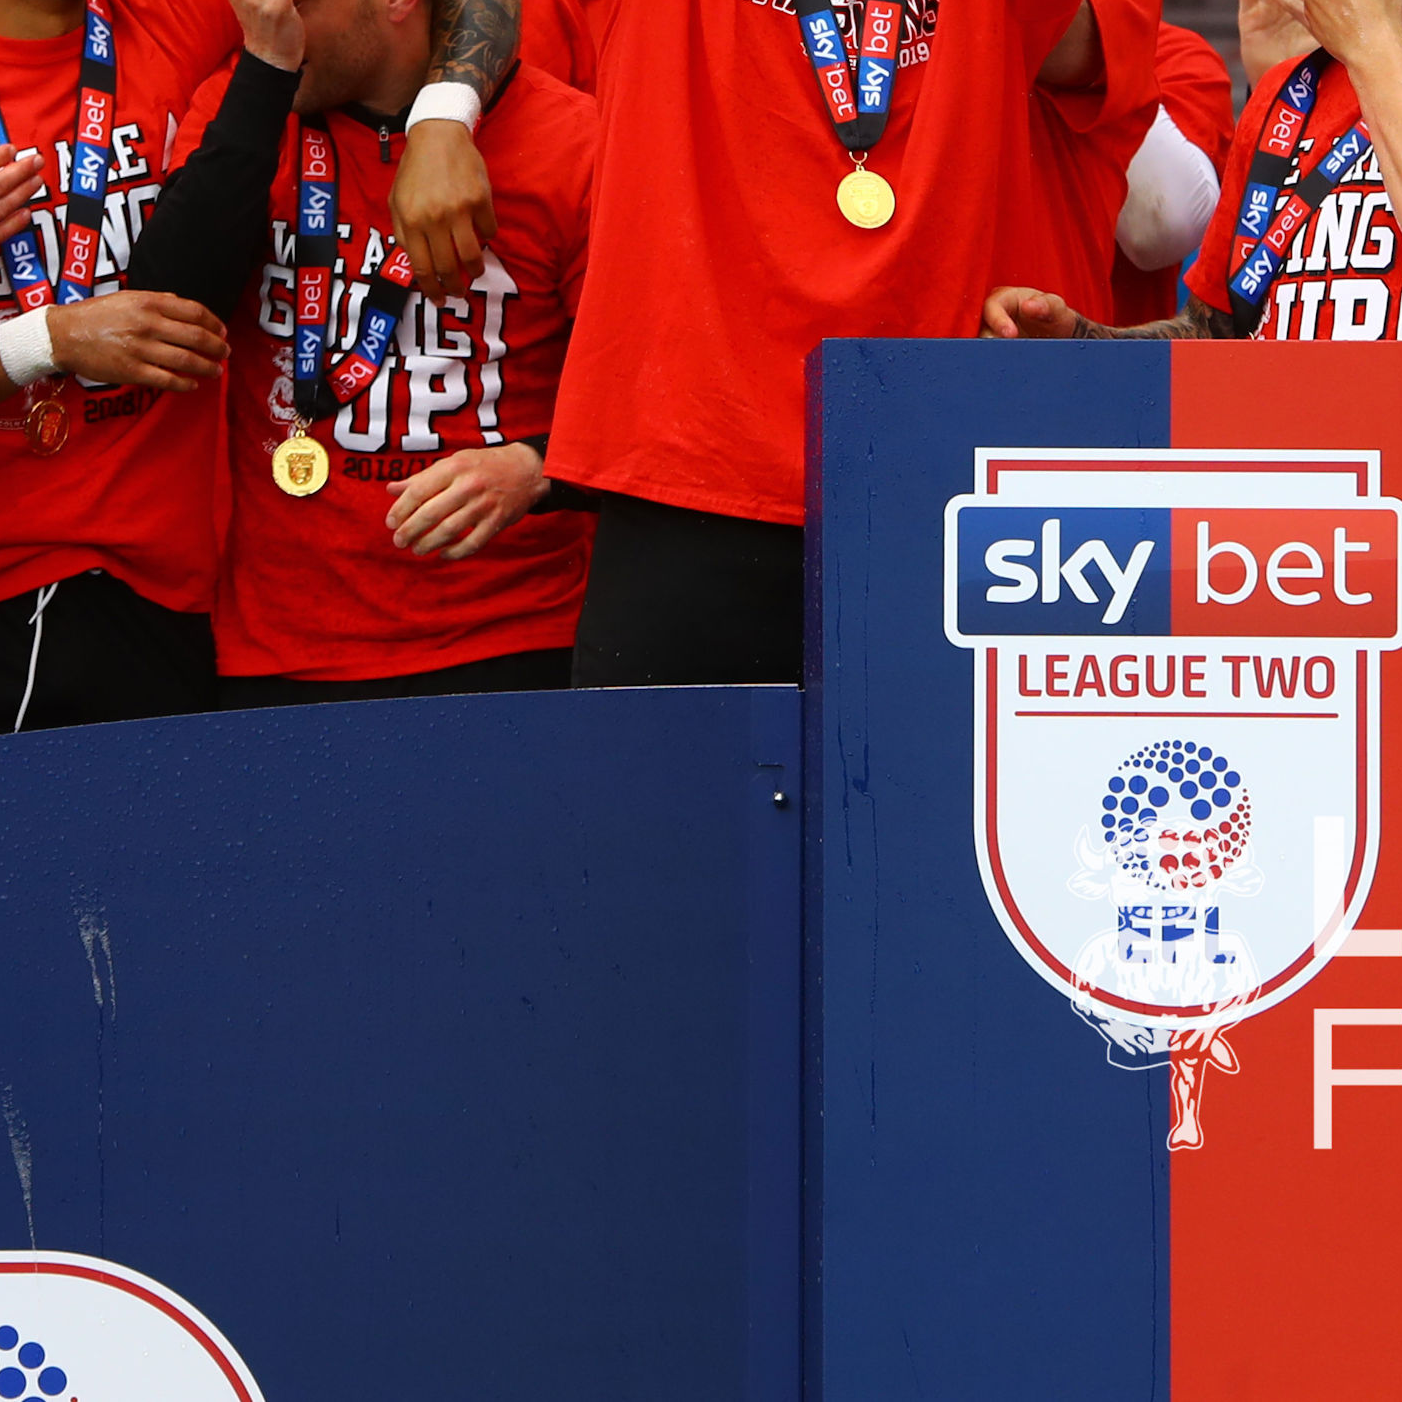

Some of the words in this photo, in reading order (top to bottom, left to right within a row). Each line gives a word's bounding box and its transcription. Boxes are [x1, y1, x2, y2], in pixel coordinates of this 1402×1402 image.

[89, 16, 111, 58] sky
[865, 7, 893, 53] bet
[809, 18, 838, 60] sky
[826, 68, 854, 116] bet
[896, 42, 931, 70] 019
[860, 60, 890, 107] sky
[1288, 68, 1312, 108] sky
[80, 96, 106, 140] bet
[1269, 108, 1302, 152] bet
[77, 145, 105, 191] sky
[304, 134, 326, 177] bet
[1326, 134, 1359, 174] sky
[303, 185, 332, 229] sky
[1242, 190, 1269, 235] sky
[12, 240, 38, 281] sky
[65, 231, 91, 279] bet
[1241, 249, 1273, 295] sky
[1268, 203, 1303, 248] bet
[299, 273, 322, 320] bet
[298, 329, 322, 373] sky
[362, 315, 387, 360] sky
[334, 361, 374, 396] bet
[984, 518, 1155, 624] sky
[1197, 521, 1373, 606] bet
[1019, 654, 1207, 698] LEAGUE
[1223, 655, 1335, 699] TWO
